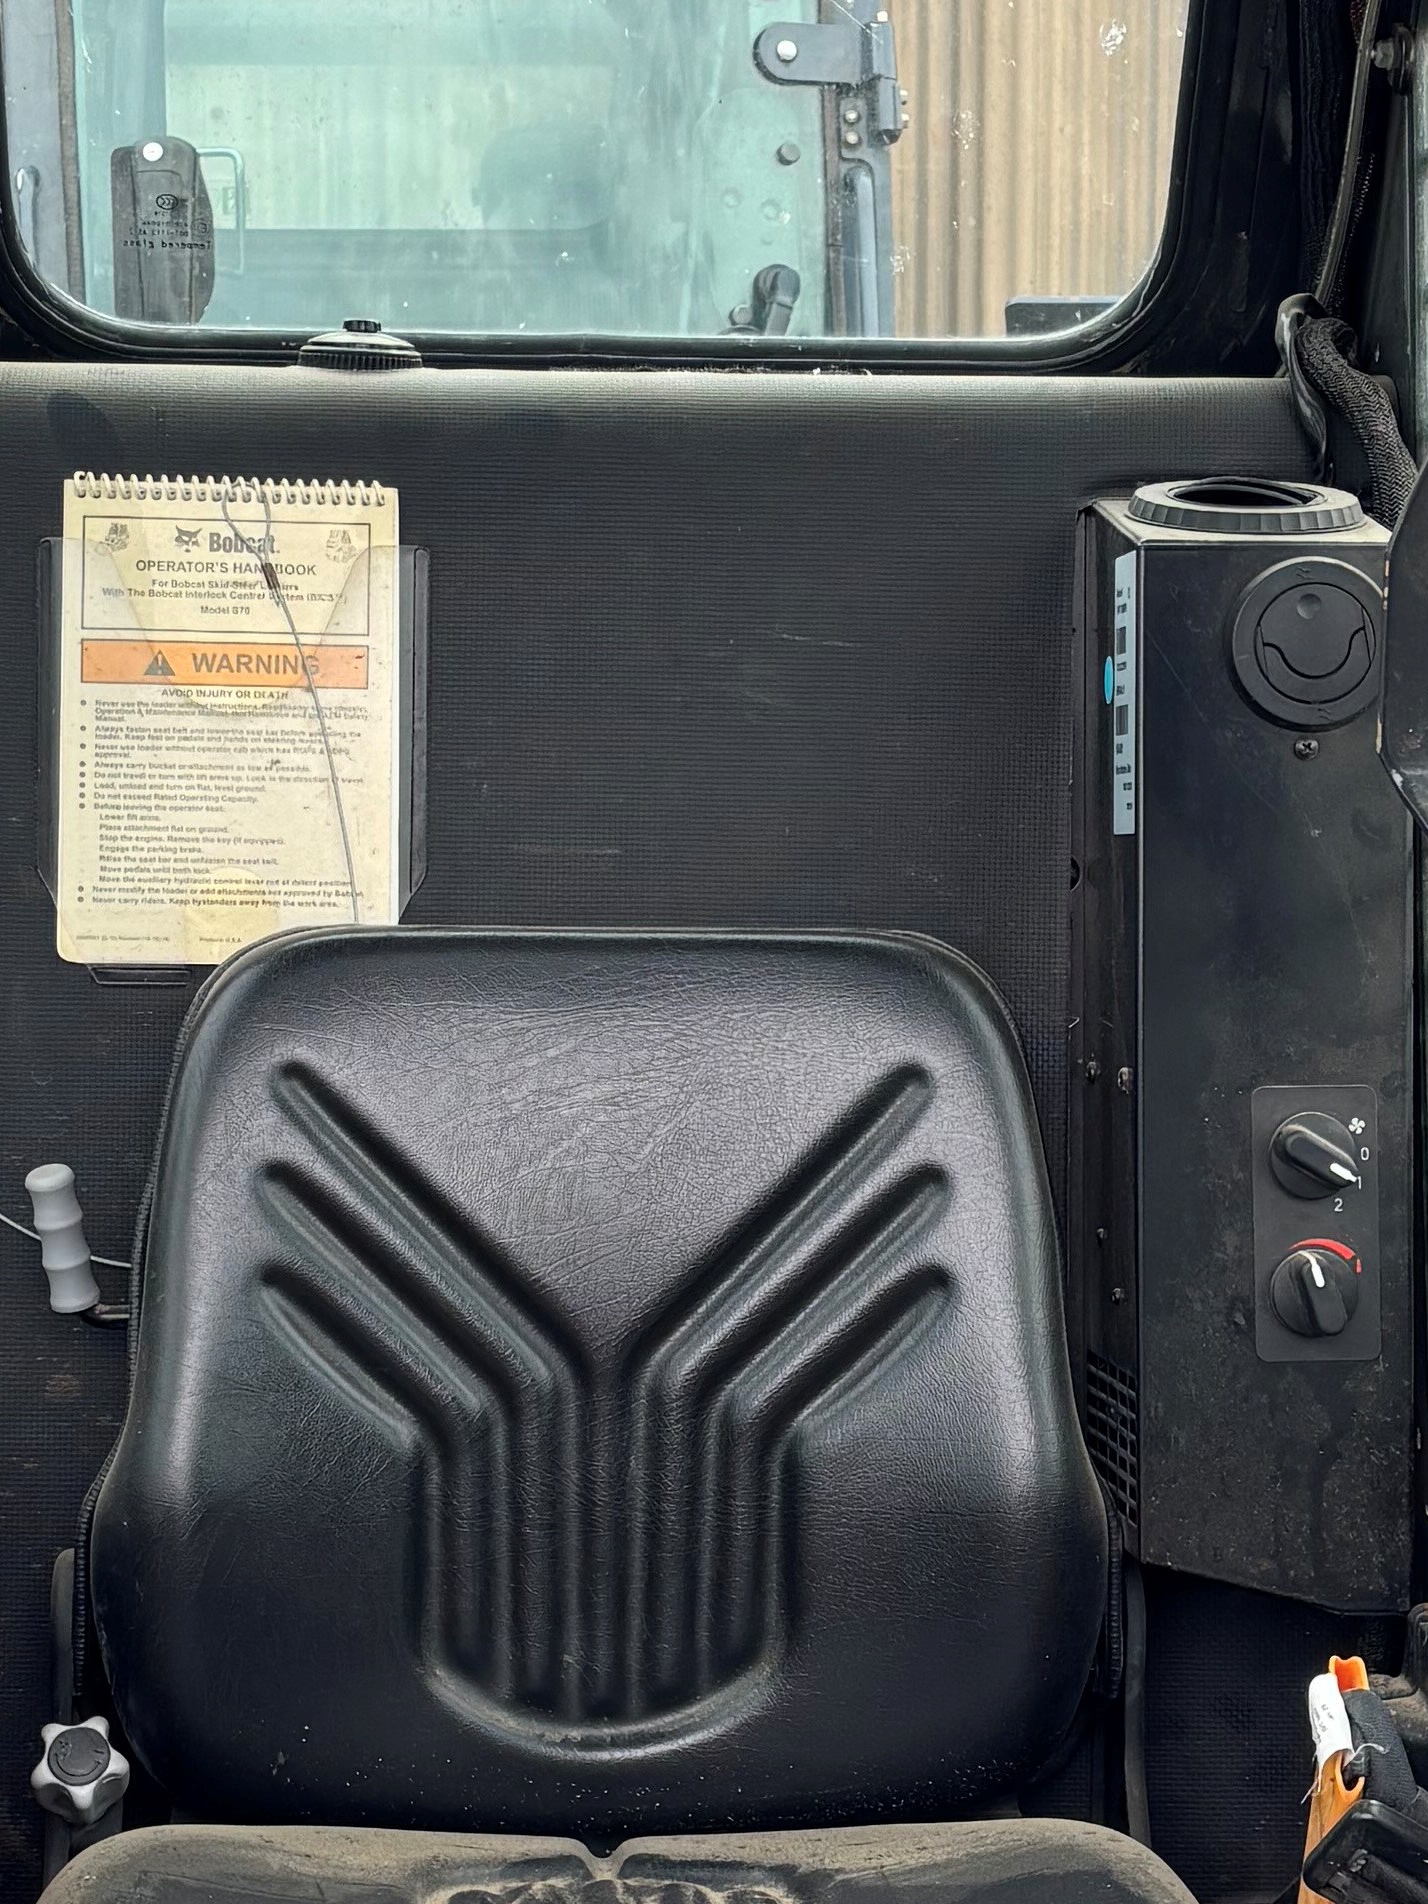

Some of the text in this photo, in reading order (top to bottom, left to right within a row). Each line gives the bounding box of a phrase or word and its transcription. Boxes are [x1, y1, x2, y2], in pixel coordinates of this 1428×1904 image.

[209, 532, 280, 554] Bobcat
[135, 560, 317, 576] OPERATOR'S HANBOOK
[152, 579, 256, 590] For Bobcat Skid-Steer
[102, 587, 265, 601] With The Bobcat Interlock Control
[200, 605, 230, 615] Model
[192, 652, 320, 676] WARNING
[161, 688, 193, 698] AVOID
[196, 689, 232, 698] INJURY
[253, 690, 288, 700] DEATH
[94, 761, 124, 770] Always
[148, 762, 176, 770] bucket
[153, 793, 177, 801] Rated
[179, 794, 220, 803] Operating
[99, 813, 124, 821] Lower
[99, 834, 118, 842] Stop
[120, 834, 133, 842] the
[147, 846, 178, 854] parking
[169, 898, 191, 907] Keep
[1360, 1147, 1369, 1161] 0
[1334, 1198, 1343, 1212] 2
